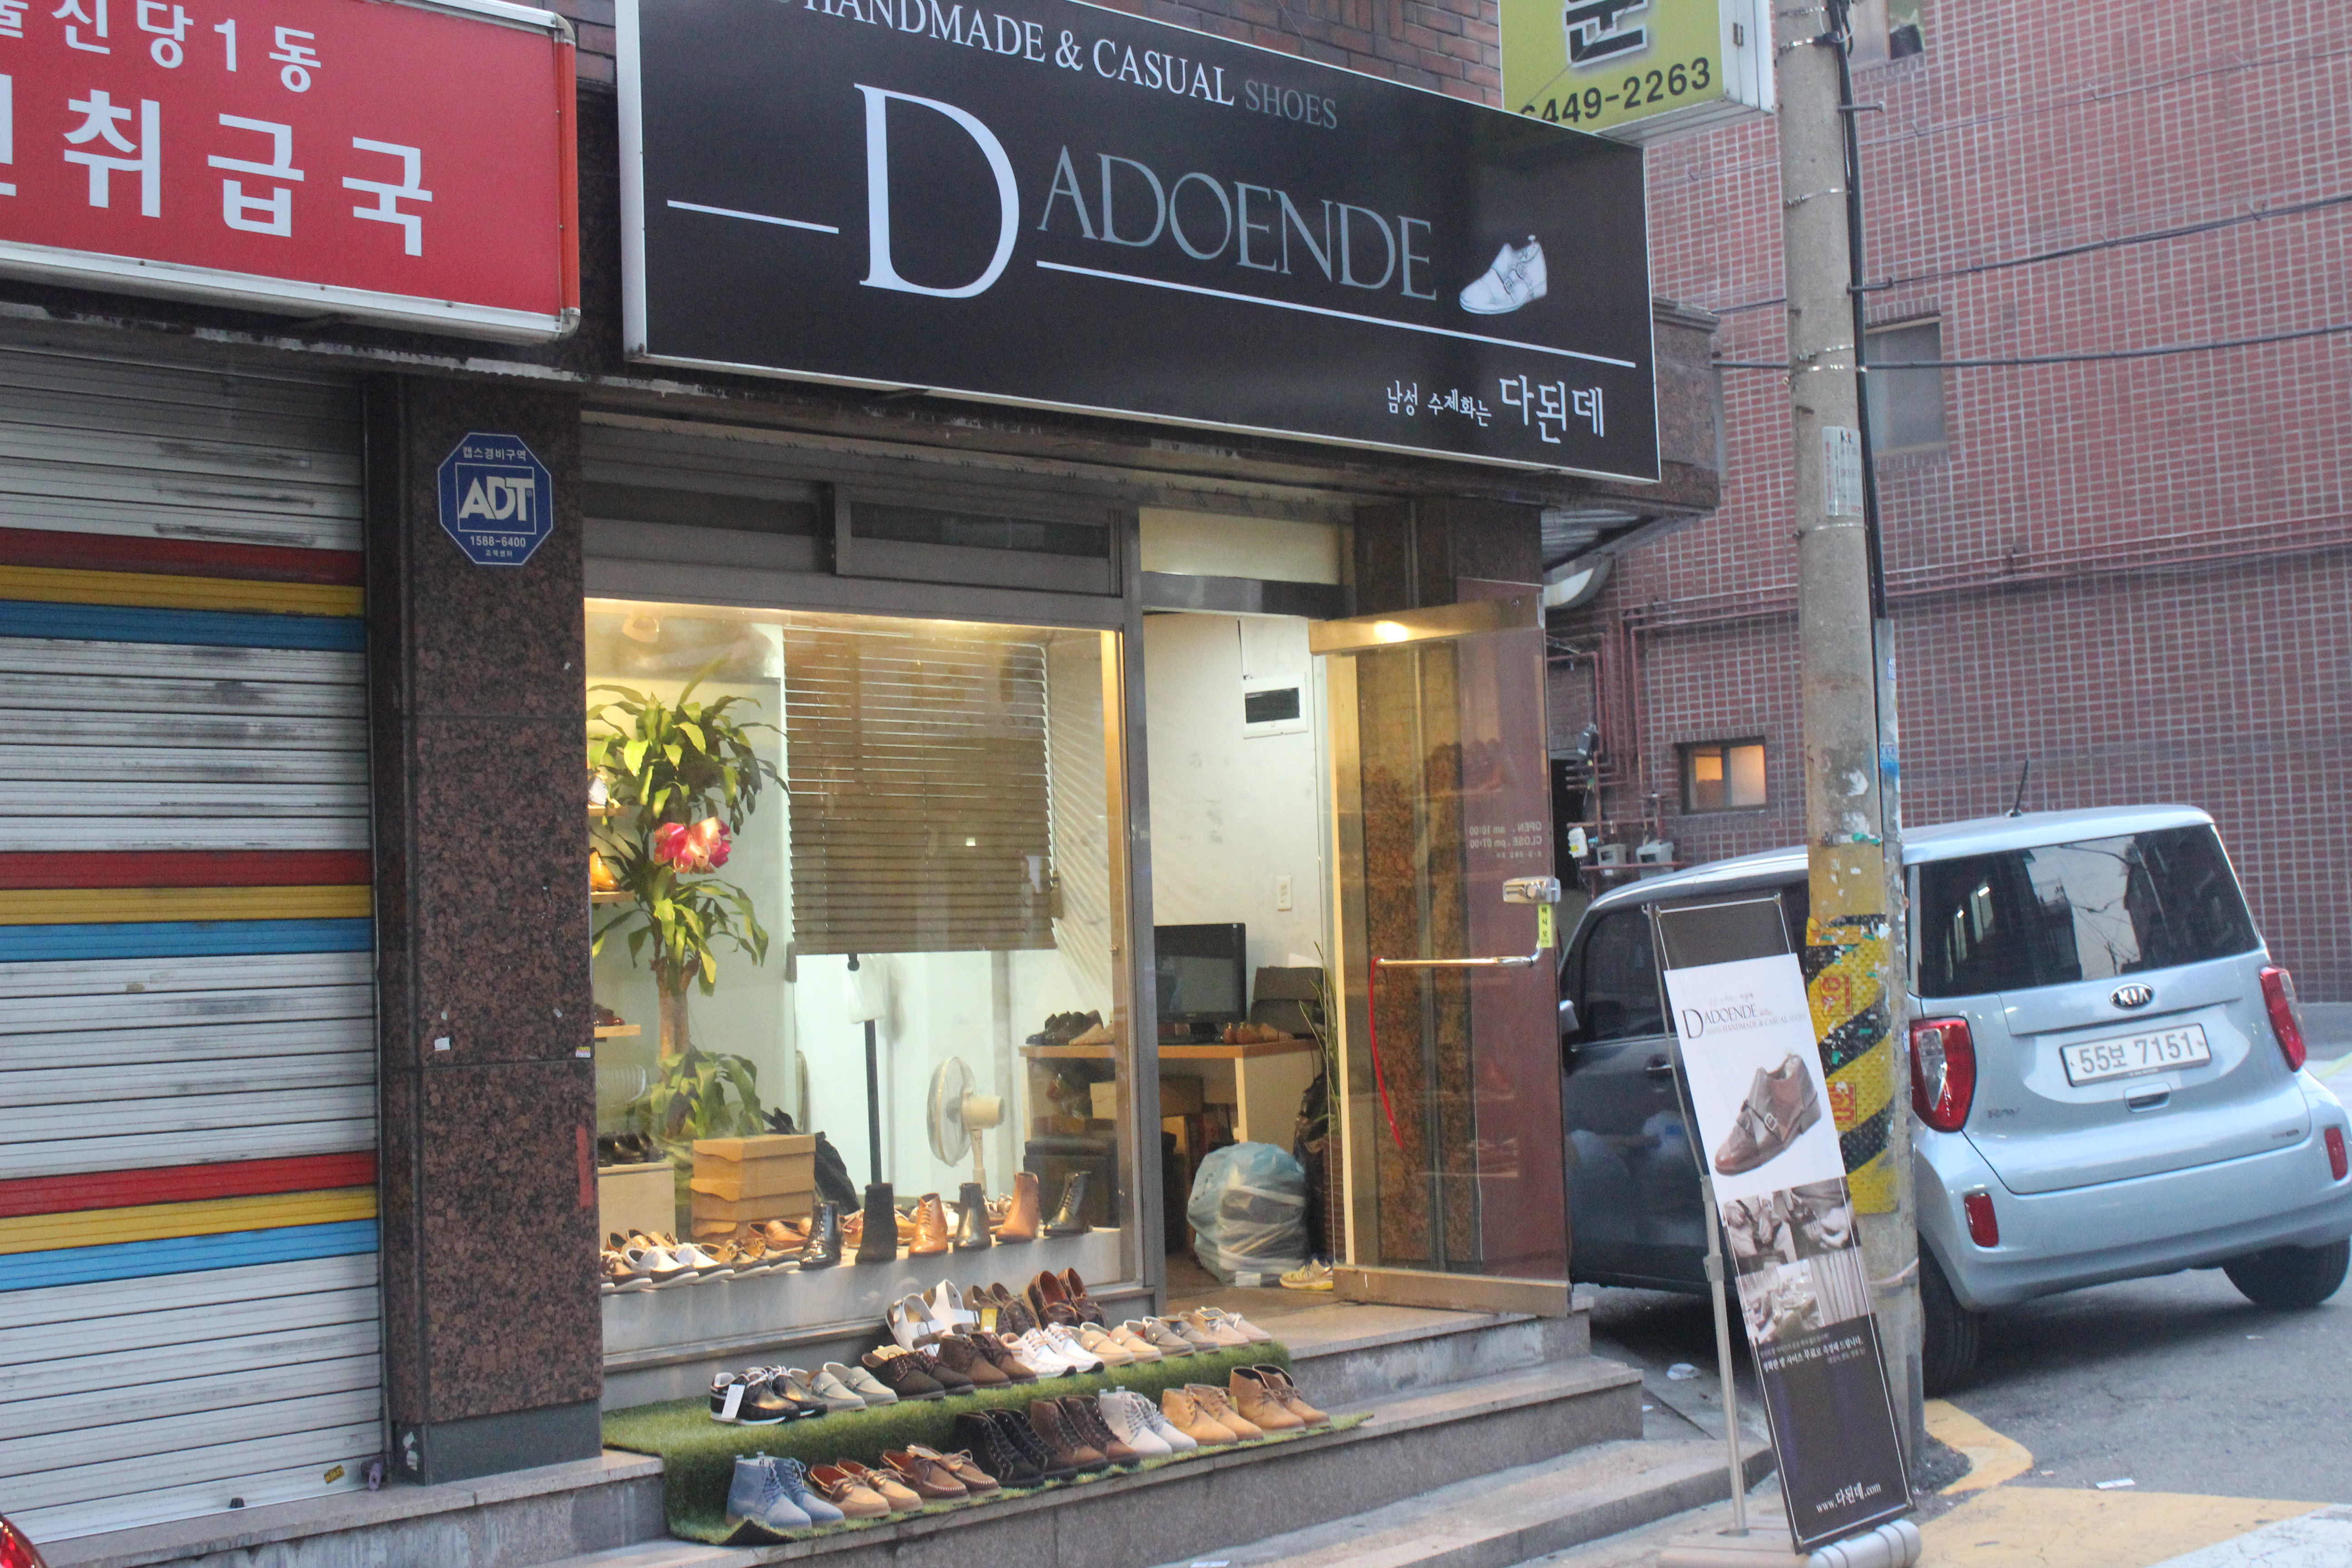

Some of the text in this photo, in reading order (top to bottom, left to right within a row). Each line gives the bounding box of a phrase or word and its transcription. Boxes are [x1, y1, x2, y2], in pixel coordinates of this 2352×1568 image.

[804, 0, 1337, 130] ANDMADE & CASUAL SHOES
[1387, 374, 1604, 444] 남성 수제화는 다된데
[1840, 430, 1852, 443] kt
[459, 476, 534, 521] ADT
[470, 535, 526, 547] 1588-6400
[2117, 986, 2151, 1006] KIA
[2079, 1031, 2193, 1073] 55보 7151
